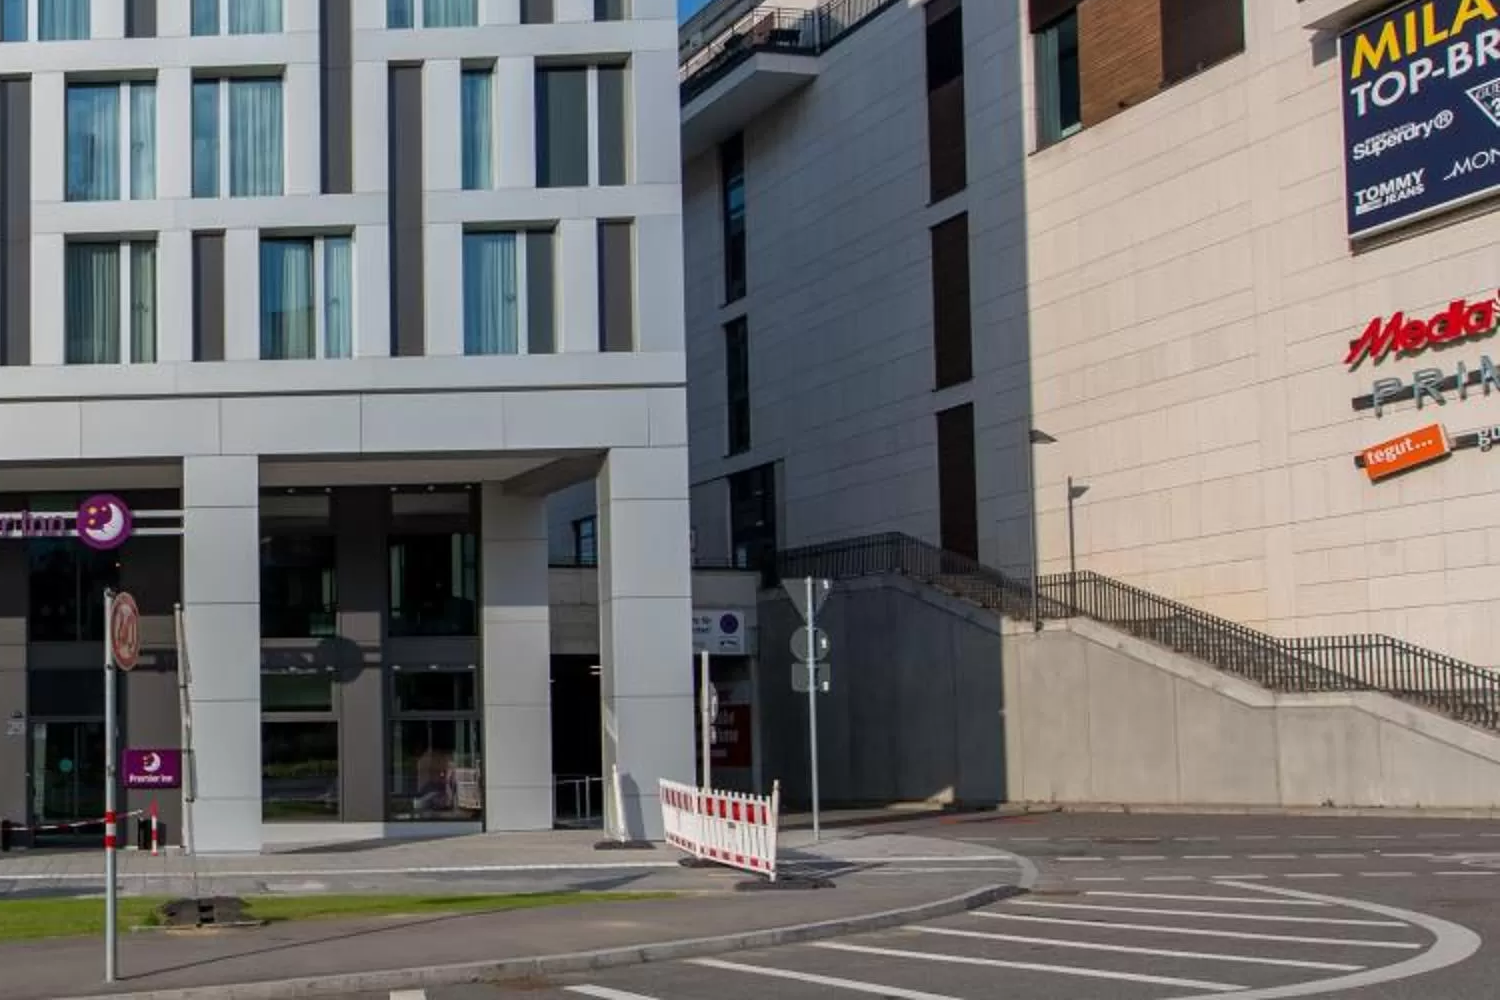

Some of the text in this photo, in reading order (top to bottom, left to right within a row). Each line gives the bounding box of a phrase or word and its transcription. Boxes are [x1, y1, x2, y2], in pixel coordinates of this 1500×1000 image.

[1354, 167, 1425, 206] TOMMY
[1383, 183, 1425, 207] JEANS
[21, 510, 67, 538] Inn
